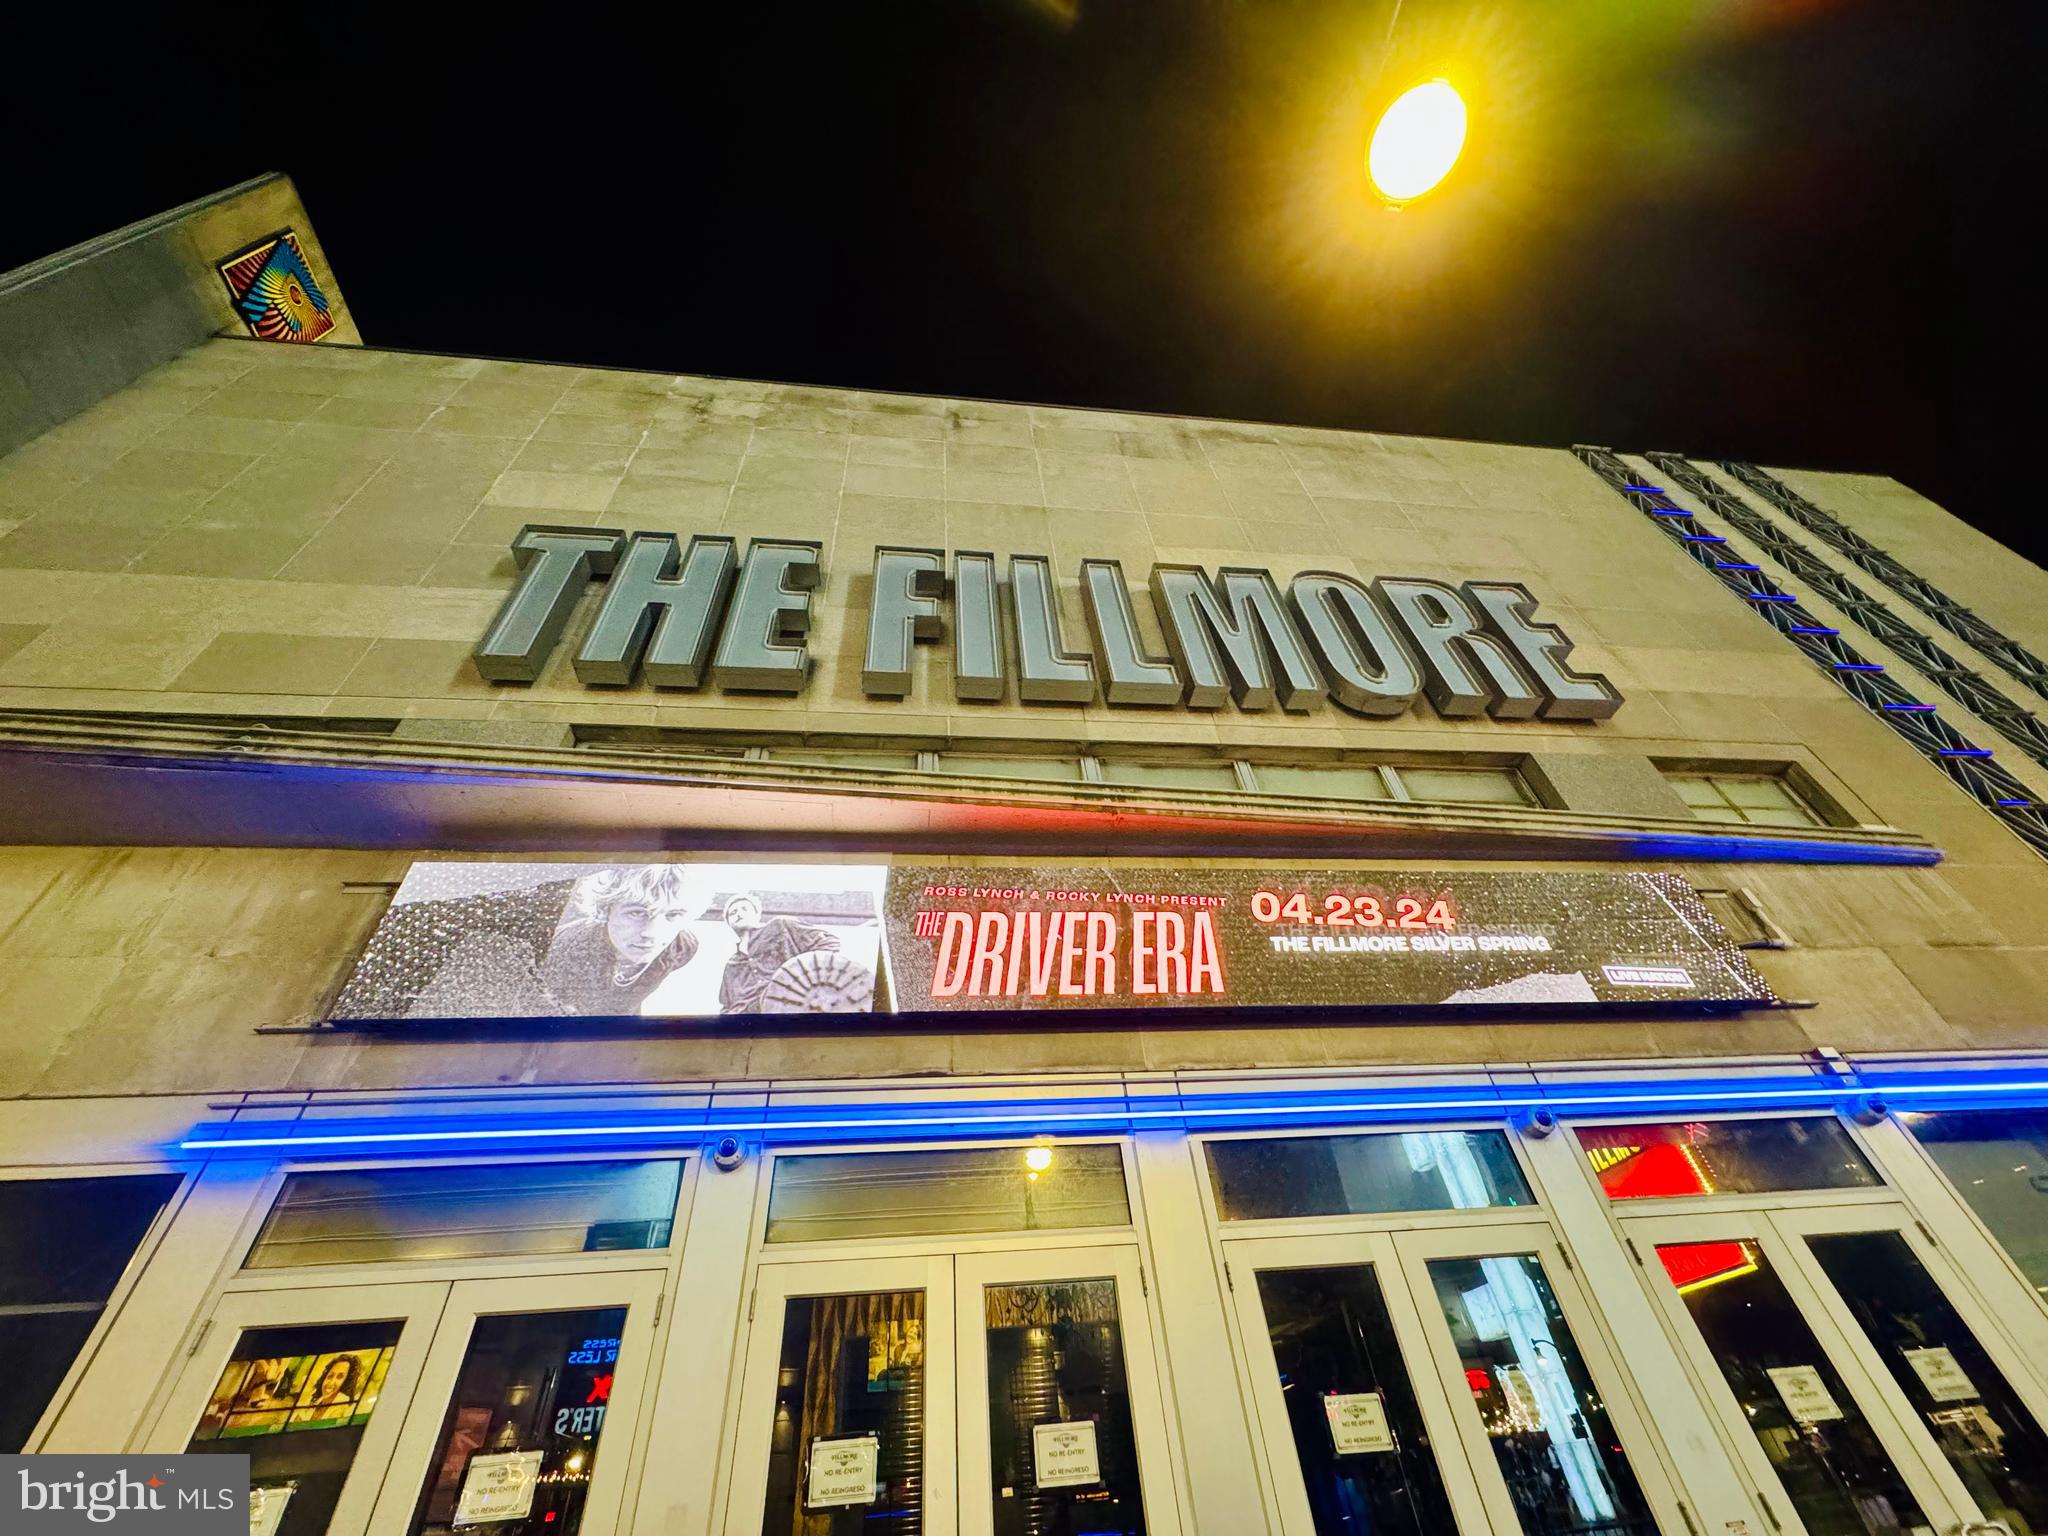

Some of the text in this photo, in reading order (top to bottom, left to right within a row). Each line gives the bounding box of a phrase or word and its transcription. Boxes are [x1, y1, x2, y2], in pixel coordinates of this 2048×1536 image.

[476, 523, 1622, 720] THE FILLMORE
[923, 885, 1228, 907] ROSS LYNCH & ROCKY LYNCH PRESENT
[1250, 890, 1456, 930] 04.23.24
[914, 911, 1226, 998] THE DRIVER ERA
[1269, 935, 1552, 953] THE FILLMORE SILVER SPRING
